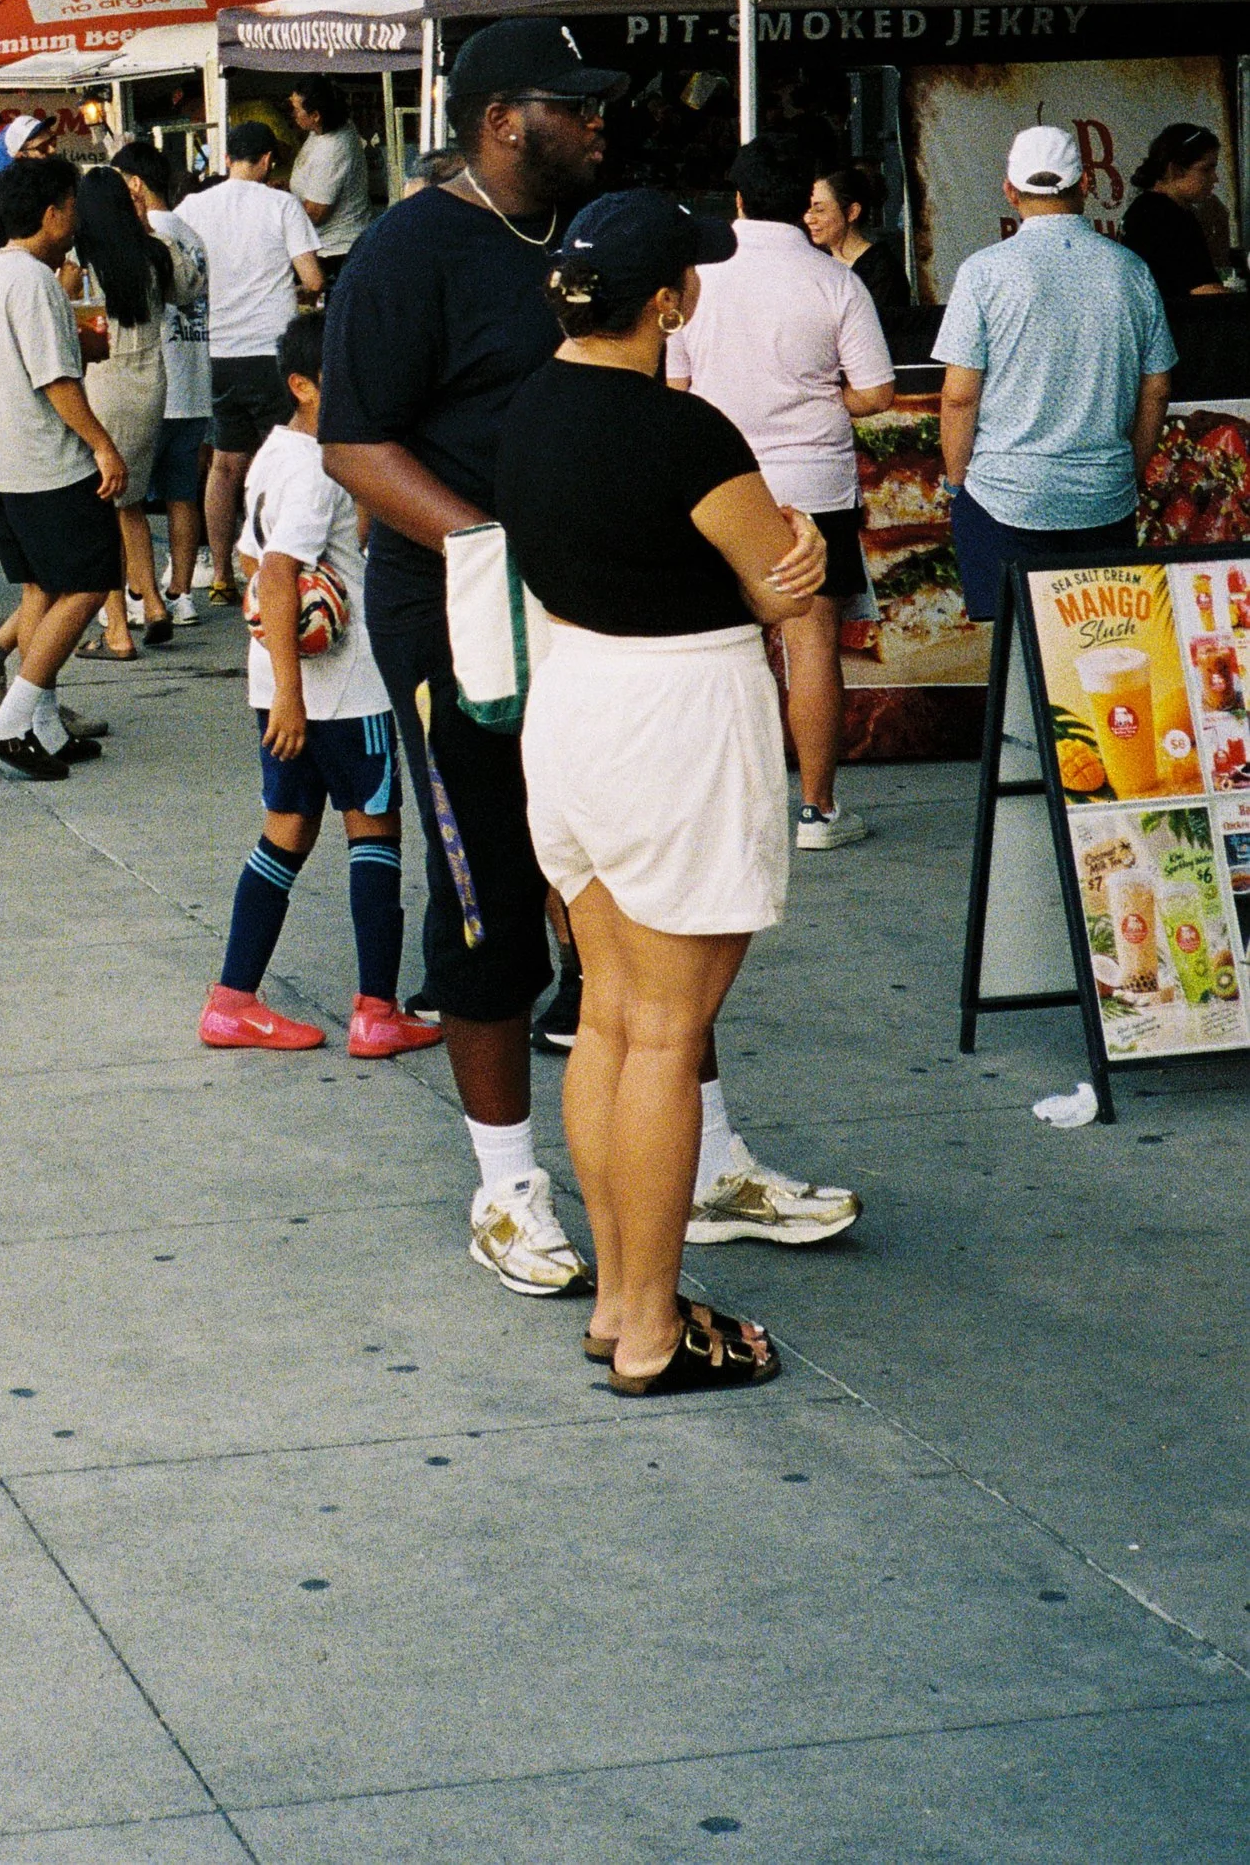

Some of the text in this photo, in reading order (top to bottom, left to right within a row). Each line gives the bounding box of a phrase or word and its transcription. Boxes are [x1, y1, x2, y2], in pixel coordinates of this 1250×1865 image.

[61, 2, 92, 15] no
[85, 27, 144, 48] Bee
[946, 5, 1087, 47] JEKRY
[1051, 569, 1142, 594] SEA SALT CREAM
[1054, 585, 1151, 627] MANGO
[1079, 617, 1136, 649] Slush
[1088, 875, 1103, 892] $7
[1197, 867, 1213, 884] $6
